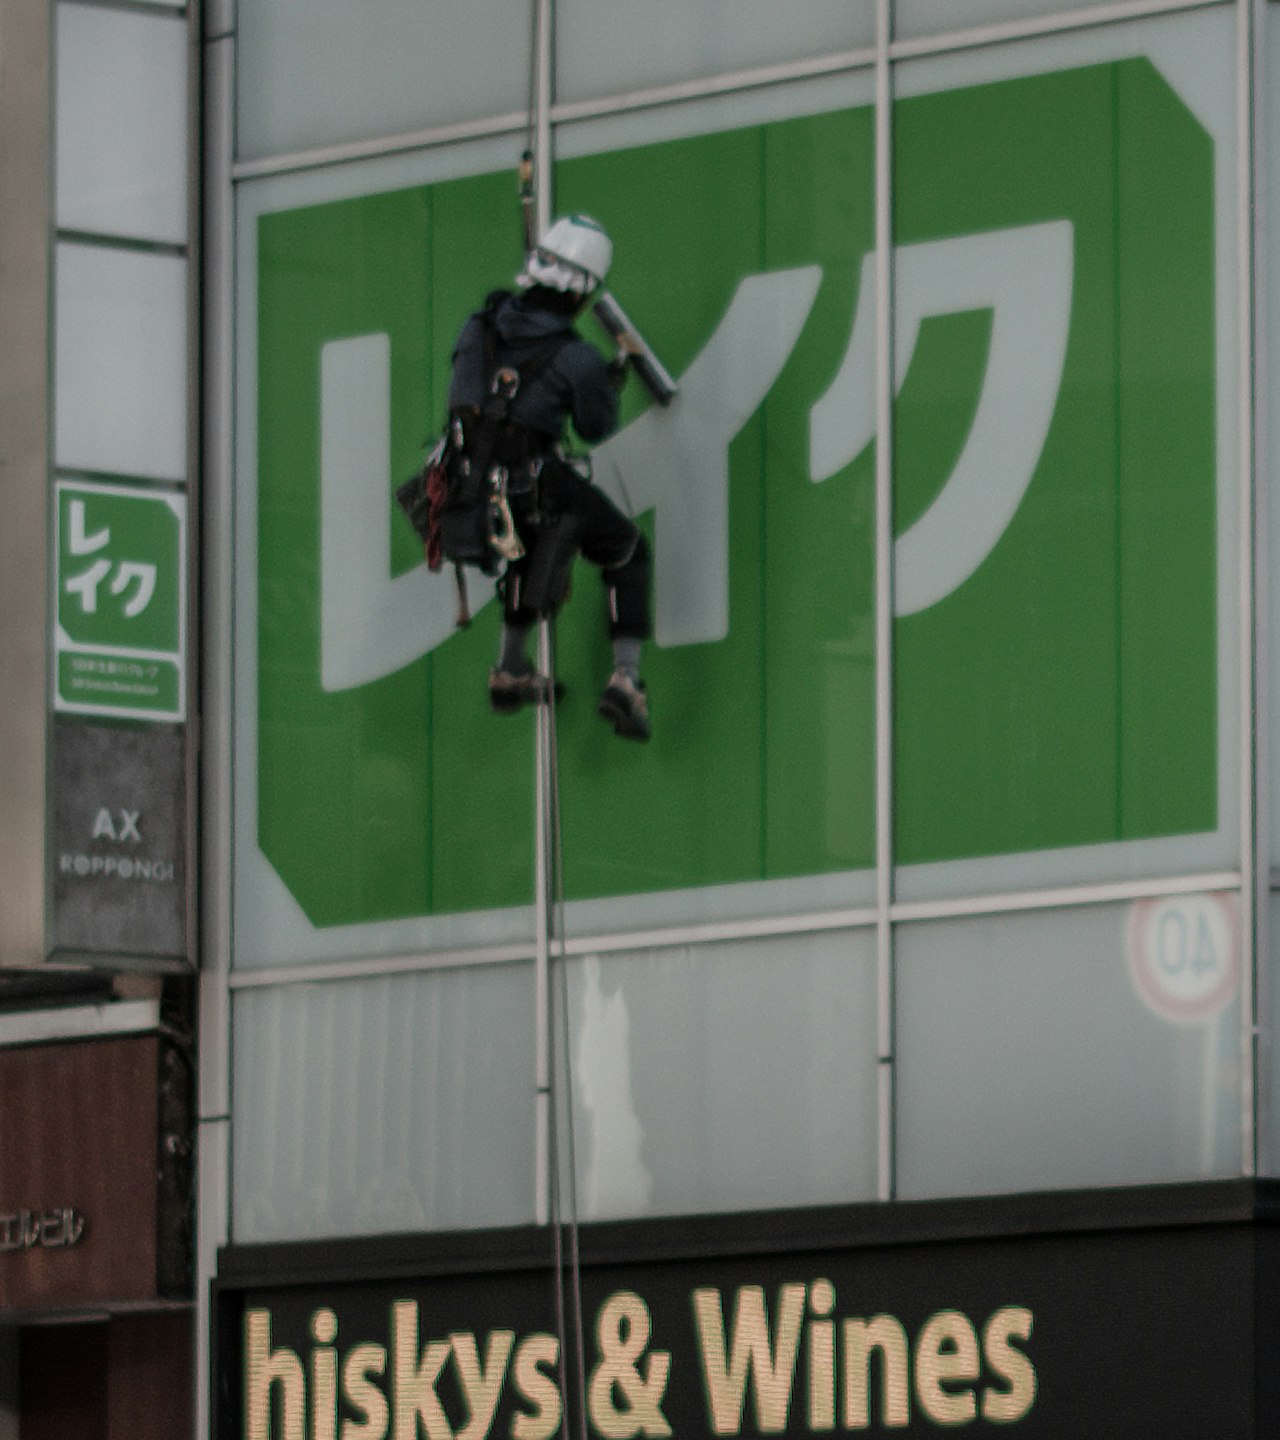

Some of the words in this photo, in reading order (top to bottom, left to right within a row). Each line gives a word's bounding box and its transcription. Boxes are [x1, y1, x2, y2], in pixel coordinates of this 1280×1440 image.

[321, 219, 1074, 692] レイク
[69, 500, 110, 555] レ
[66, 558, 158, 619] イク
[93, 807, 142, 844] AX
[692, 1279, 1037, 1438] Wines
